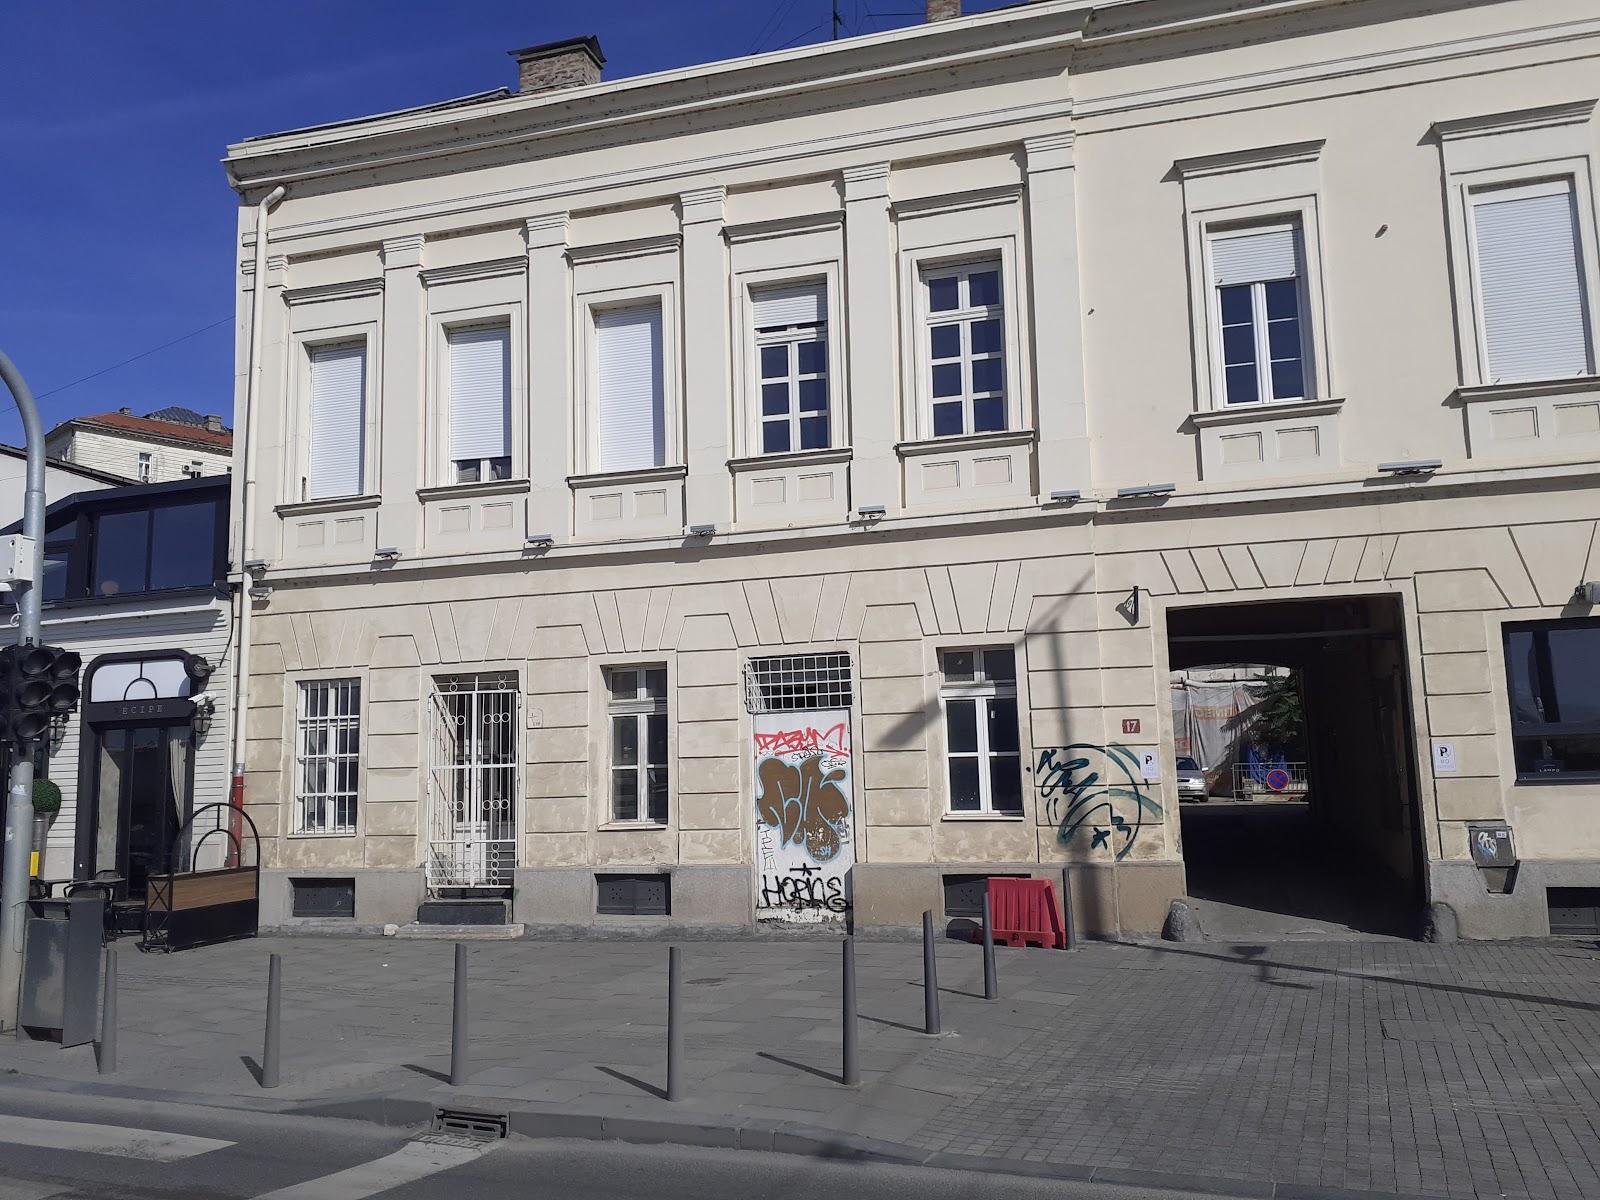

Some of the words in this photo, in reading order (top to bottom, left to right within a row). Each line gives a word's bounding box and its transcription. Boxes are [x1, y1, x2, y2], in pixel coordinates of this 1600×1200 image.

[1126, 720, 1138, 732] 17
[1440, 746, 1448, 757] P
[1145, 755, 1153, 765] P
